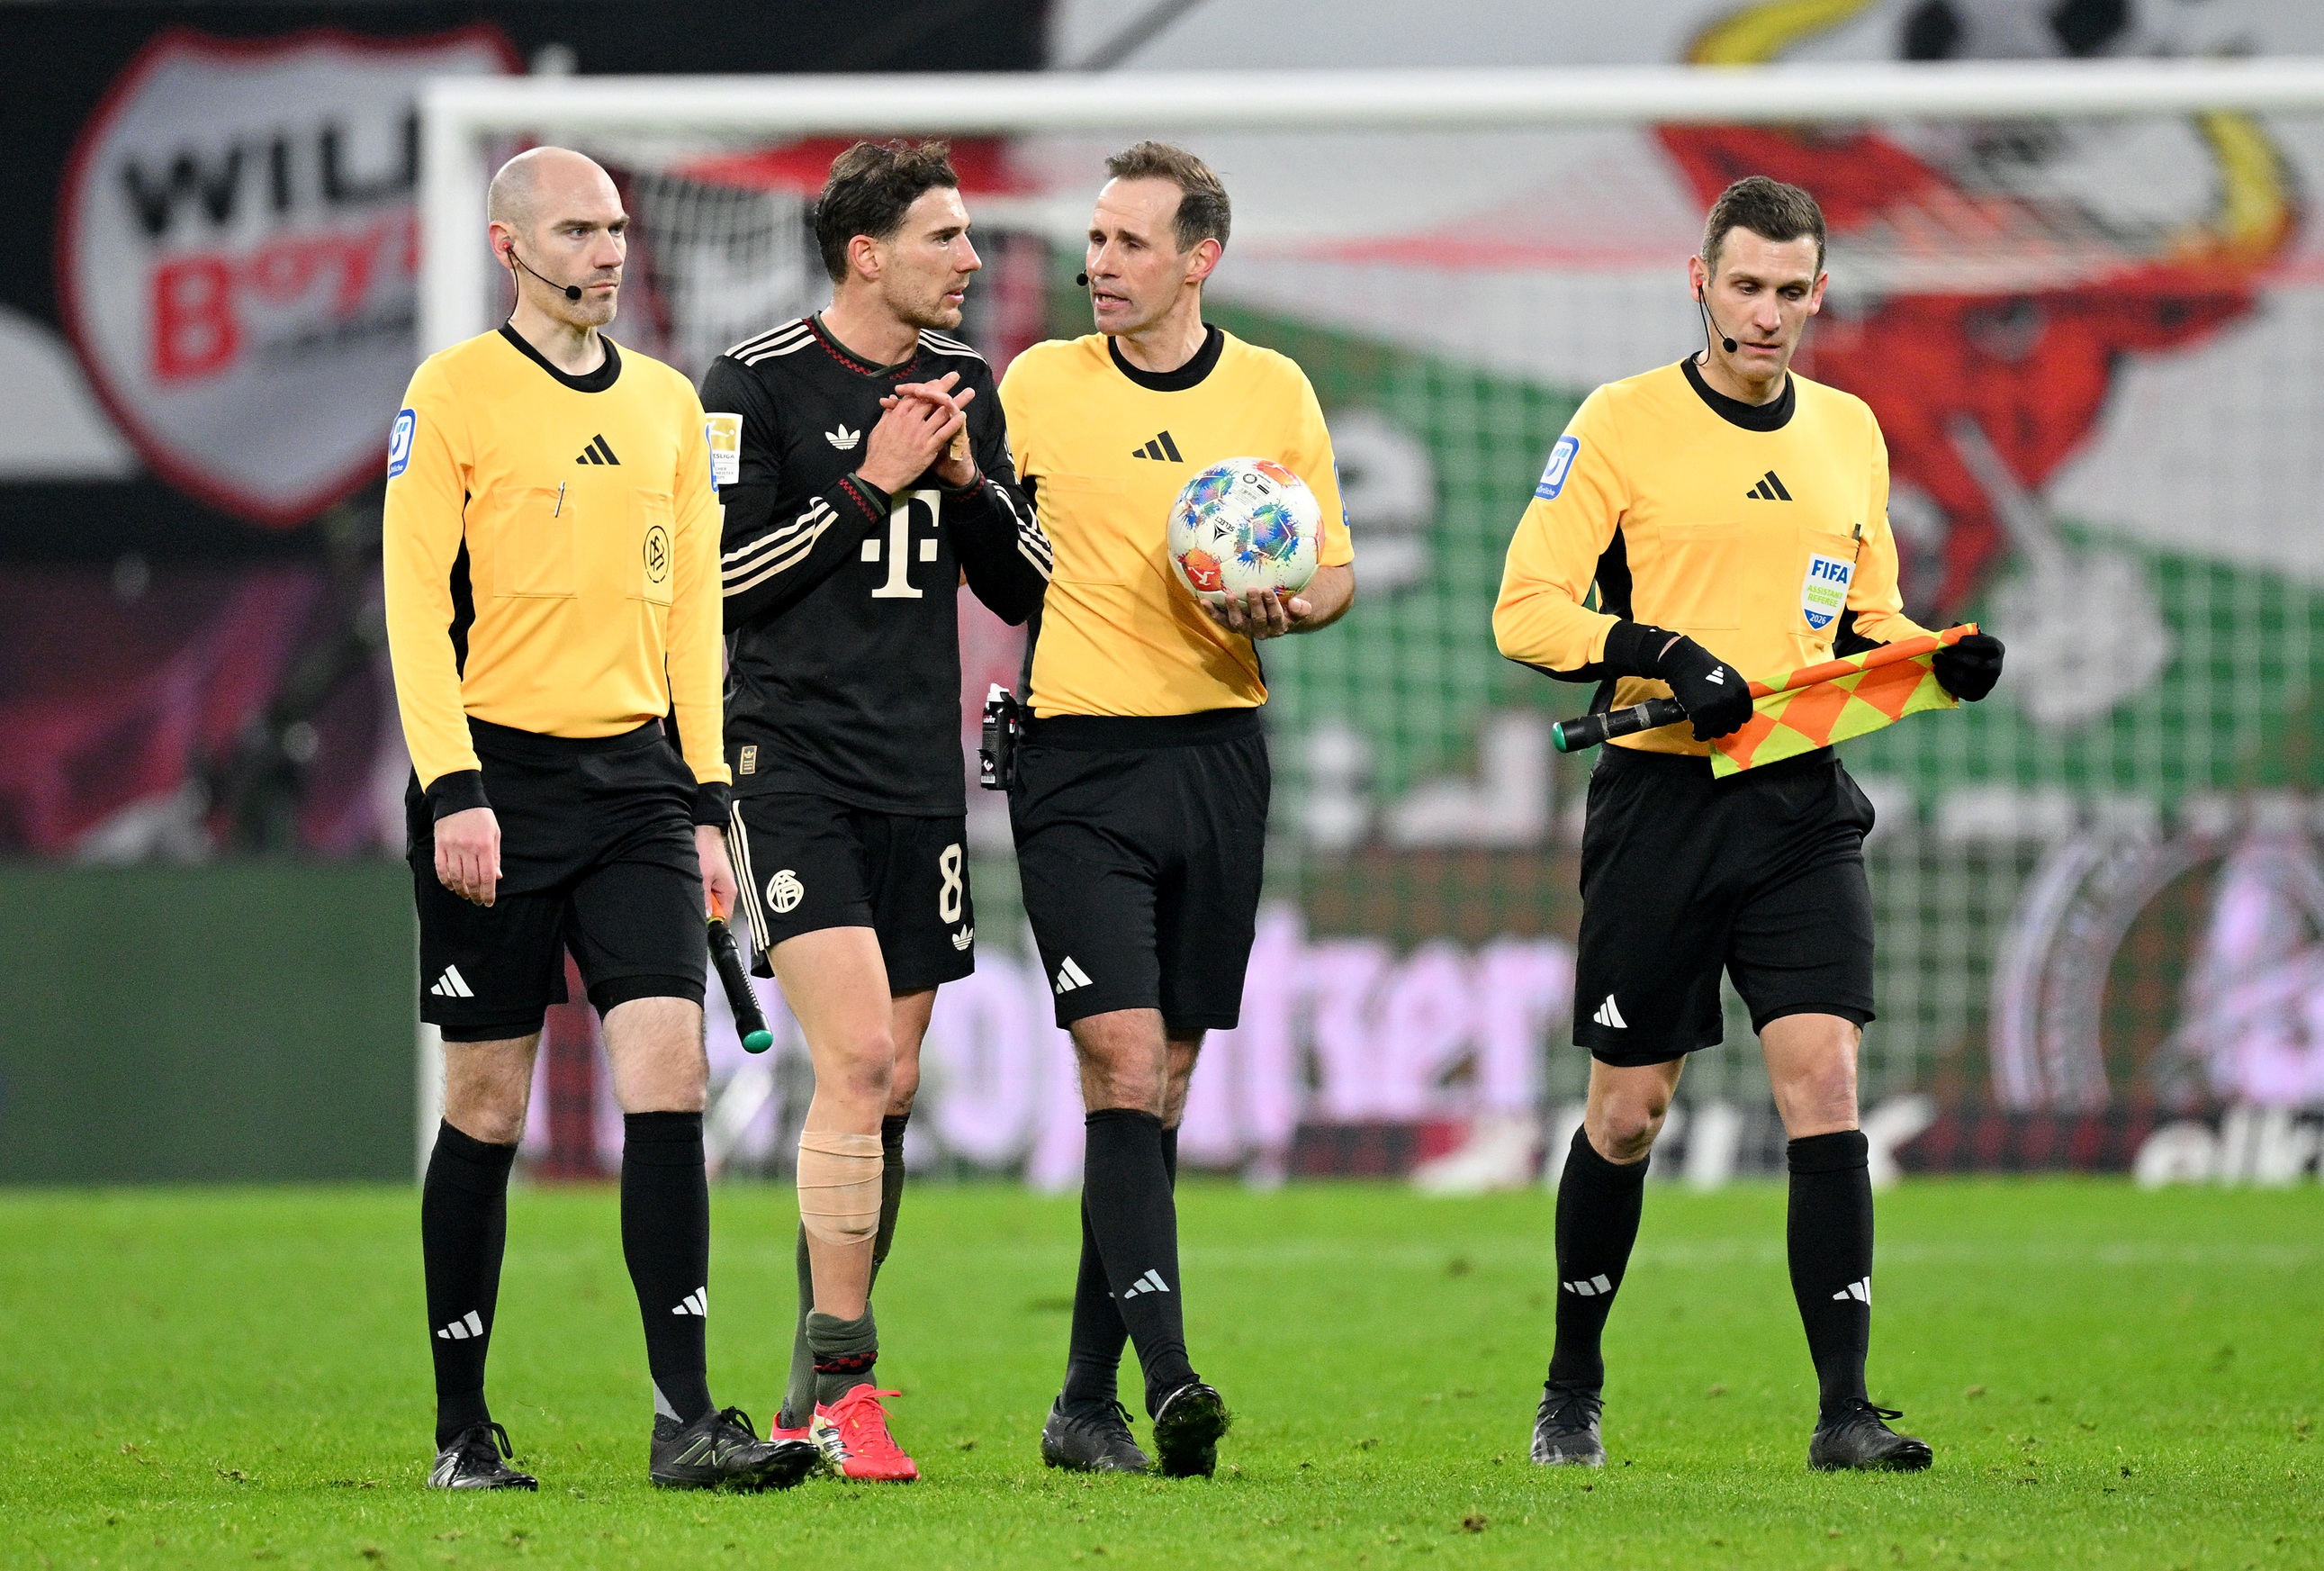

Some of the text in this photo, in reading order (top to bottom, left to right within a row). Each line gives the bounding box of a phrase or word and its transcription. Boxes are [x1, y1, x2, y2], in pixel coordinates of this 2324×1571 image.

[1214, 516, 1235, 532] SELECT
[1811, 559, 1850, 583] FIFA
[1806, 584, 1843, 600] ASSISTANT
[1807, 593, 1838, 608] REFEREE
[1809, 613, 1827, 625] 2026
[939, 843, 963, 924] 8
